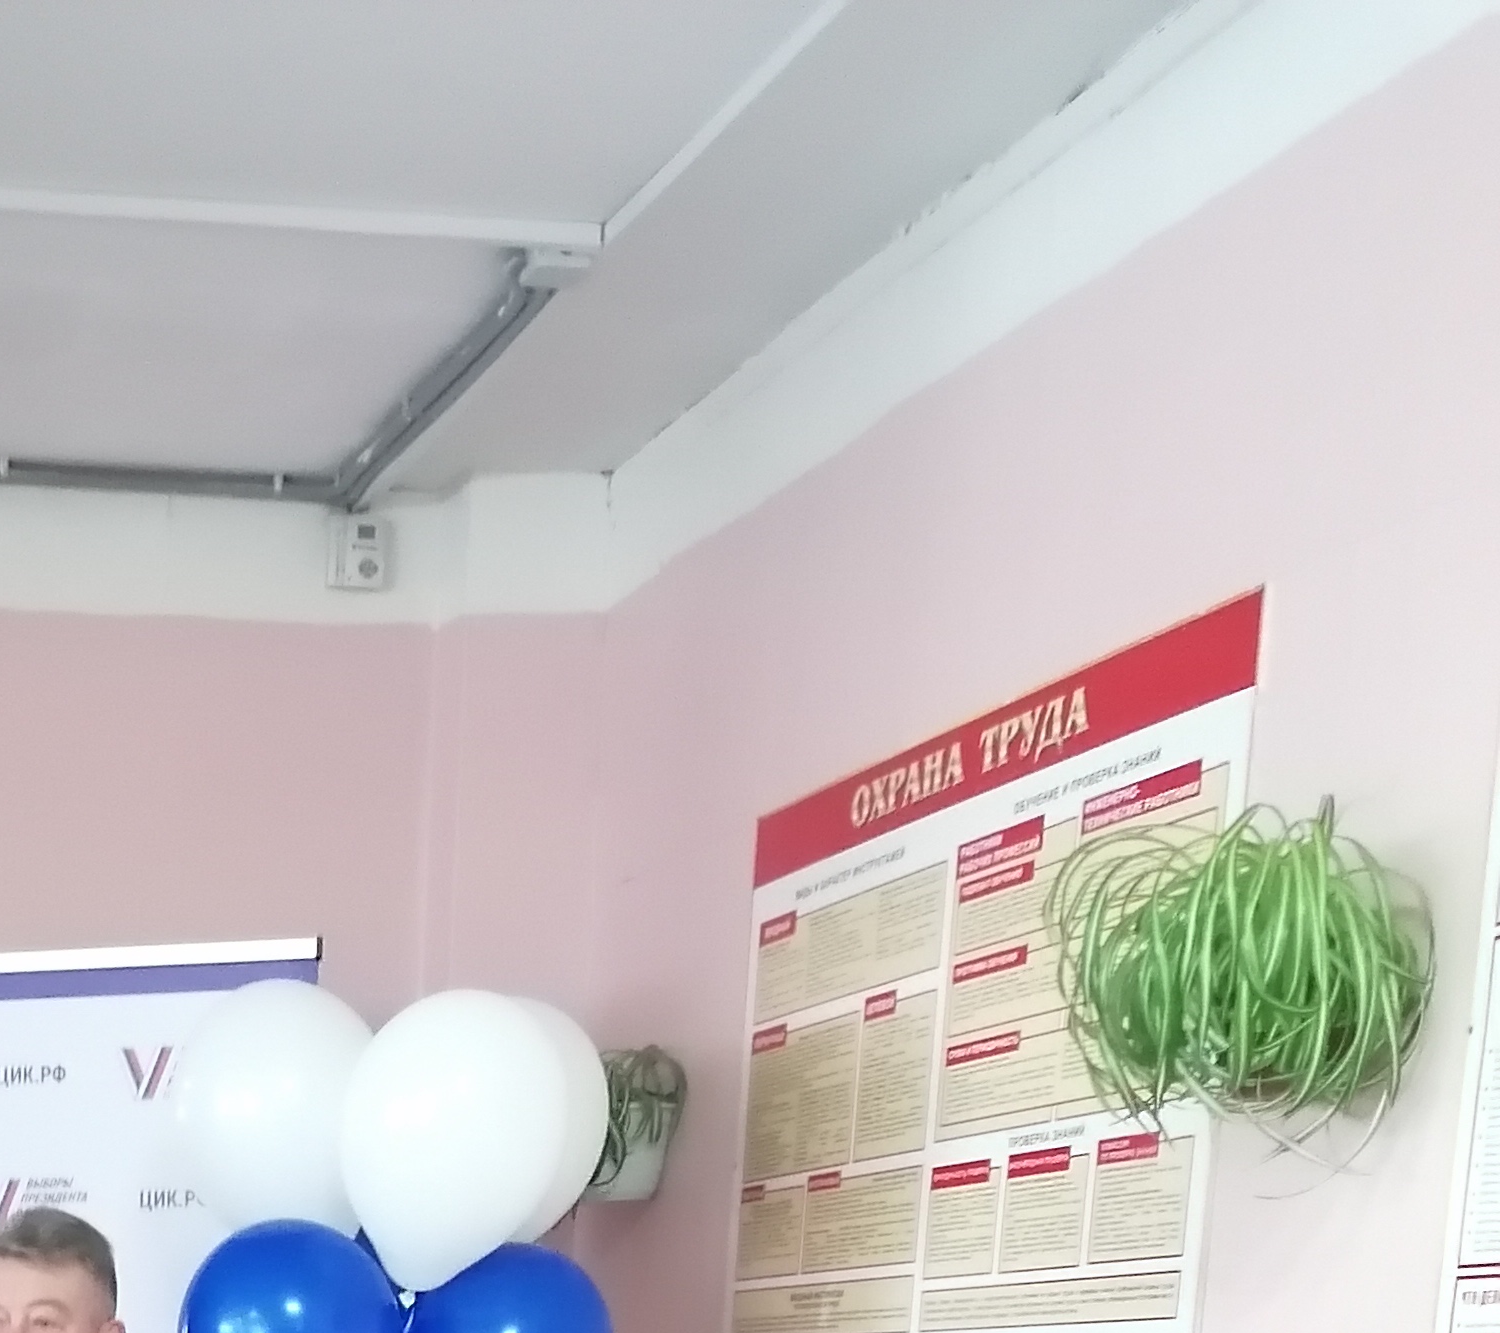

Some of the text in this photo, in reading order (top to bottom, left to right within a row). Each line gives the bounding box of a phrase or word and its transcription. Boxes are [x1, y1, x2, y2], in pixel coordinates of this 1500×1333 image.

[850, 686, 1090, 829] ОХРАНА ТРУДА
[26, 1176, 74, 1190] ВЫБОРЫ
[20, 1191, 88, 1204] ПРЕЗИДЕНТА
[139, 1188, 205, 1211] ЦИК.Р
